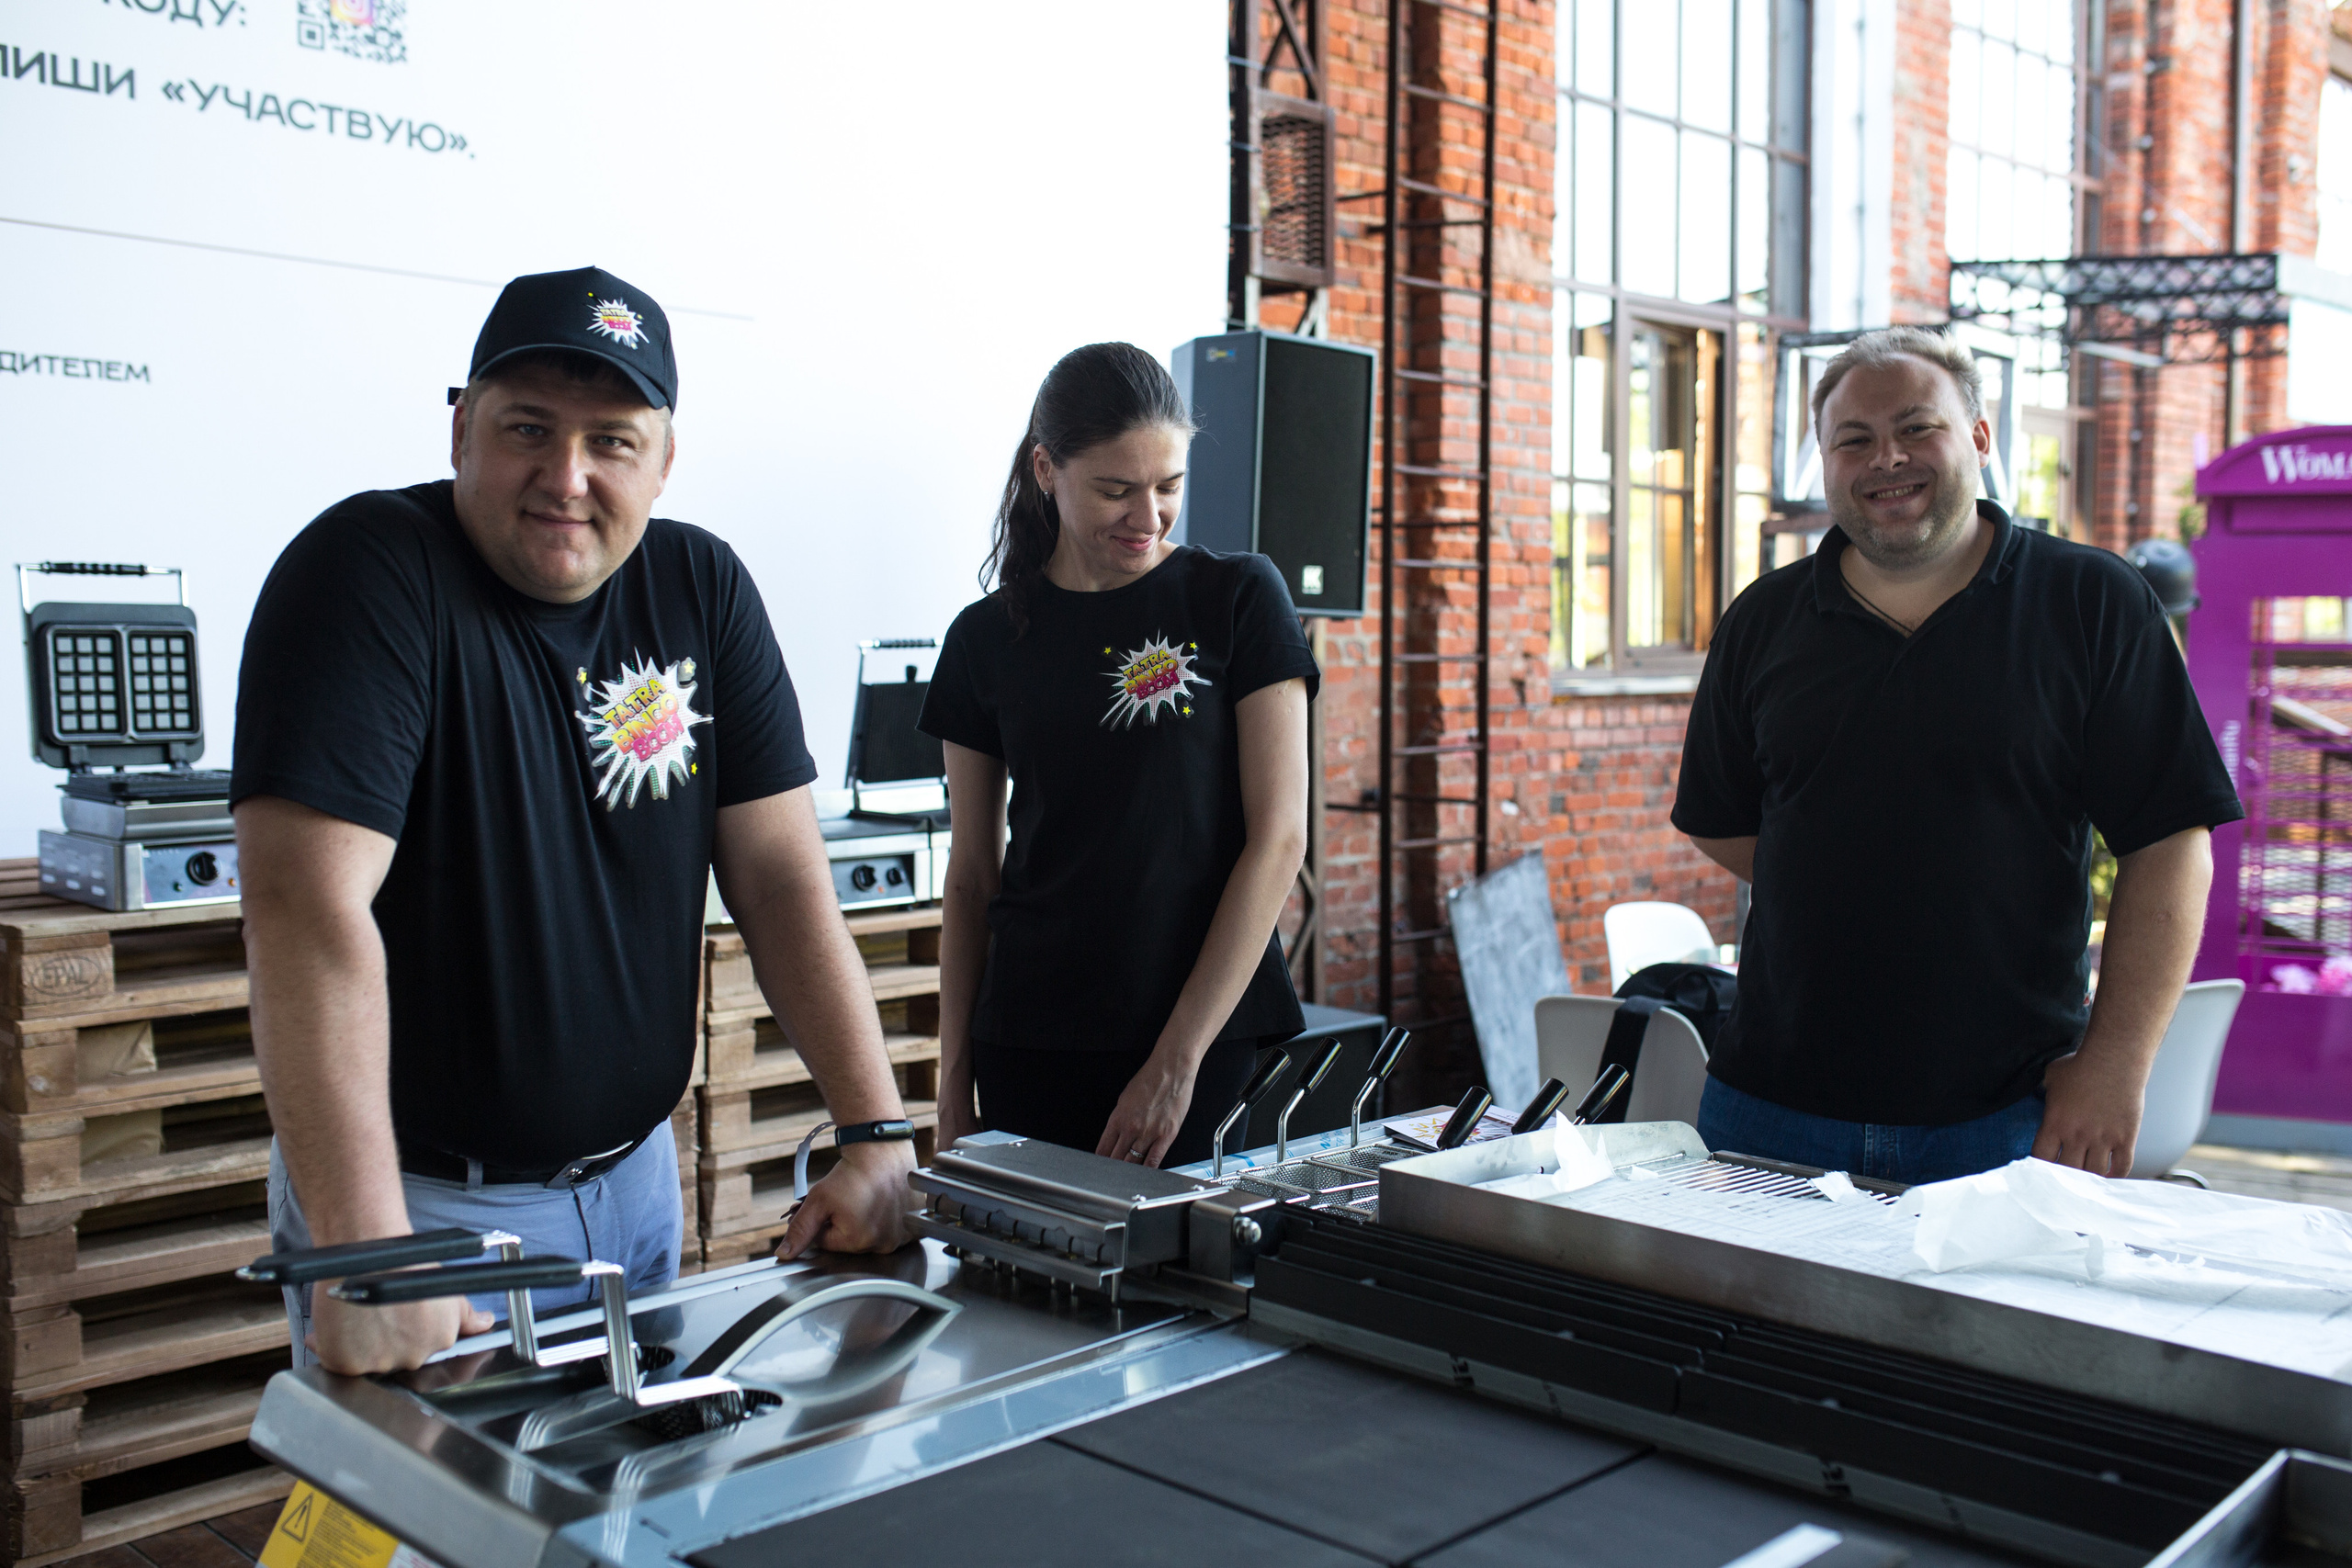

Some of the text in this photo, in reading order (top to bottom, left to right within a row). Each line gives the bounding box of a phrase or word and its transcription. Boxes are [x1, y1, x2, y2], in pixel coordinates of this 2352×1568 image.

[1123, 649, 1171, 680] TATRA
[1124, 659, 1179, 695] BINGO
[1136, 670, 1180, 700] BOOM
[603, 679, 666, 729] TATRA
[611, 693, 679, 754] BINGO
[631, 713, 684, 761] BOOM
